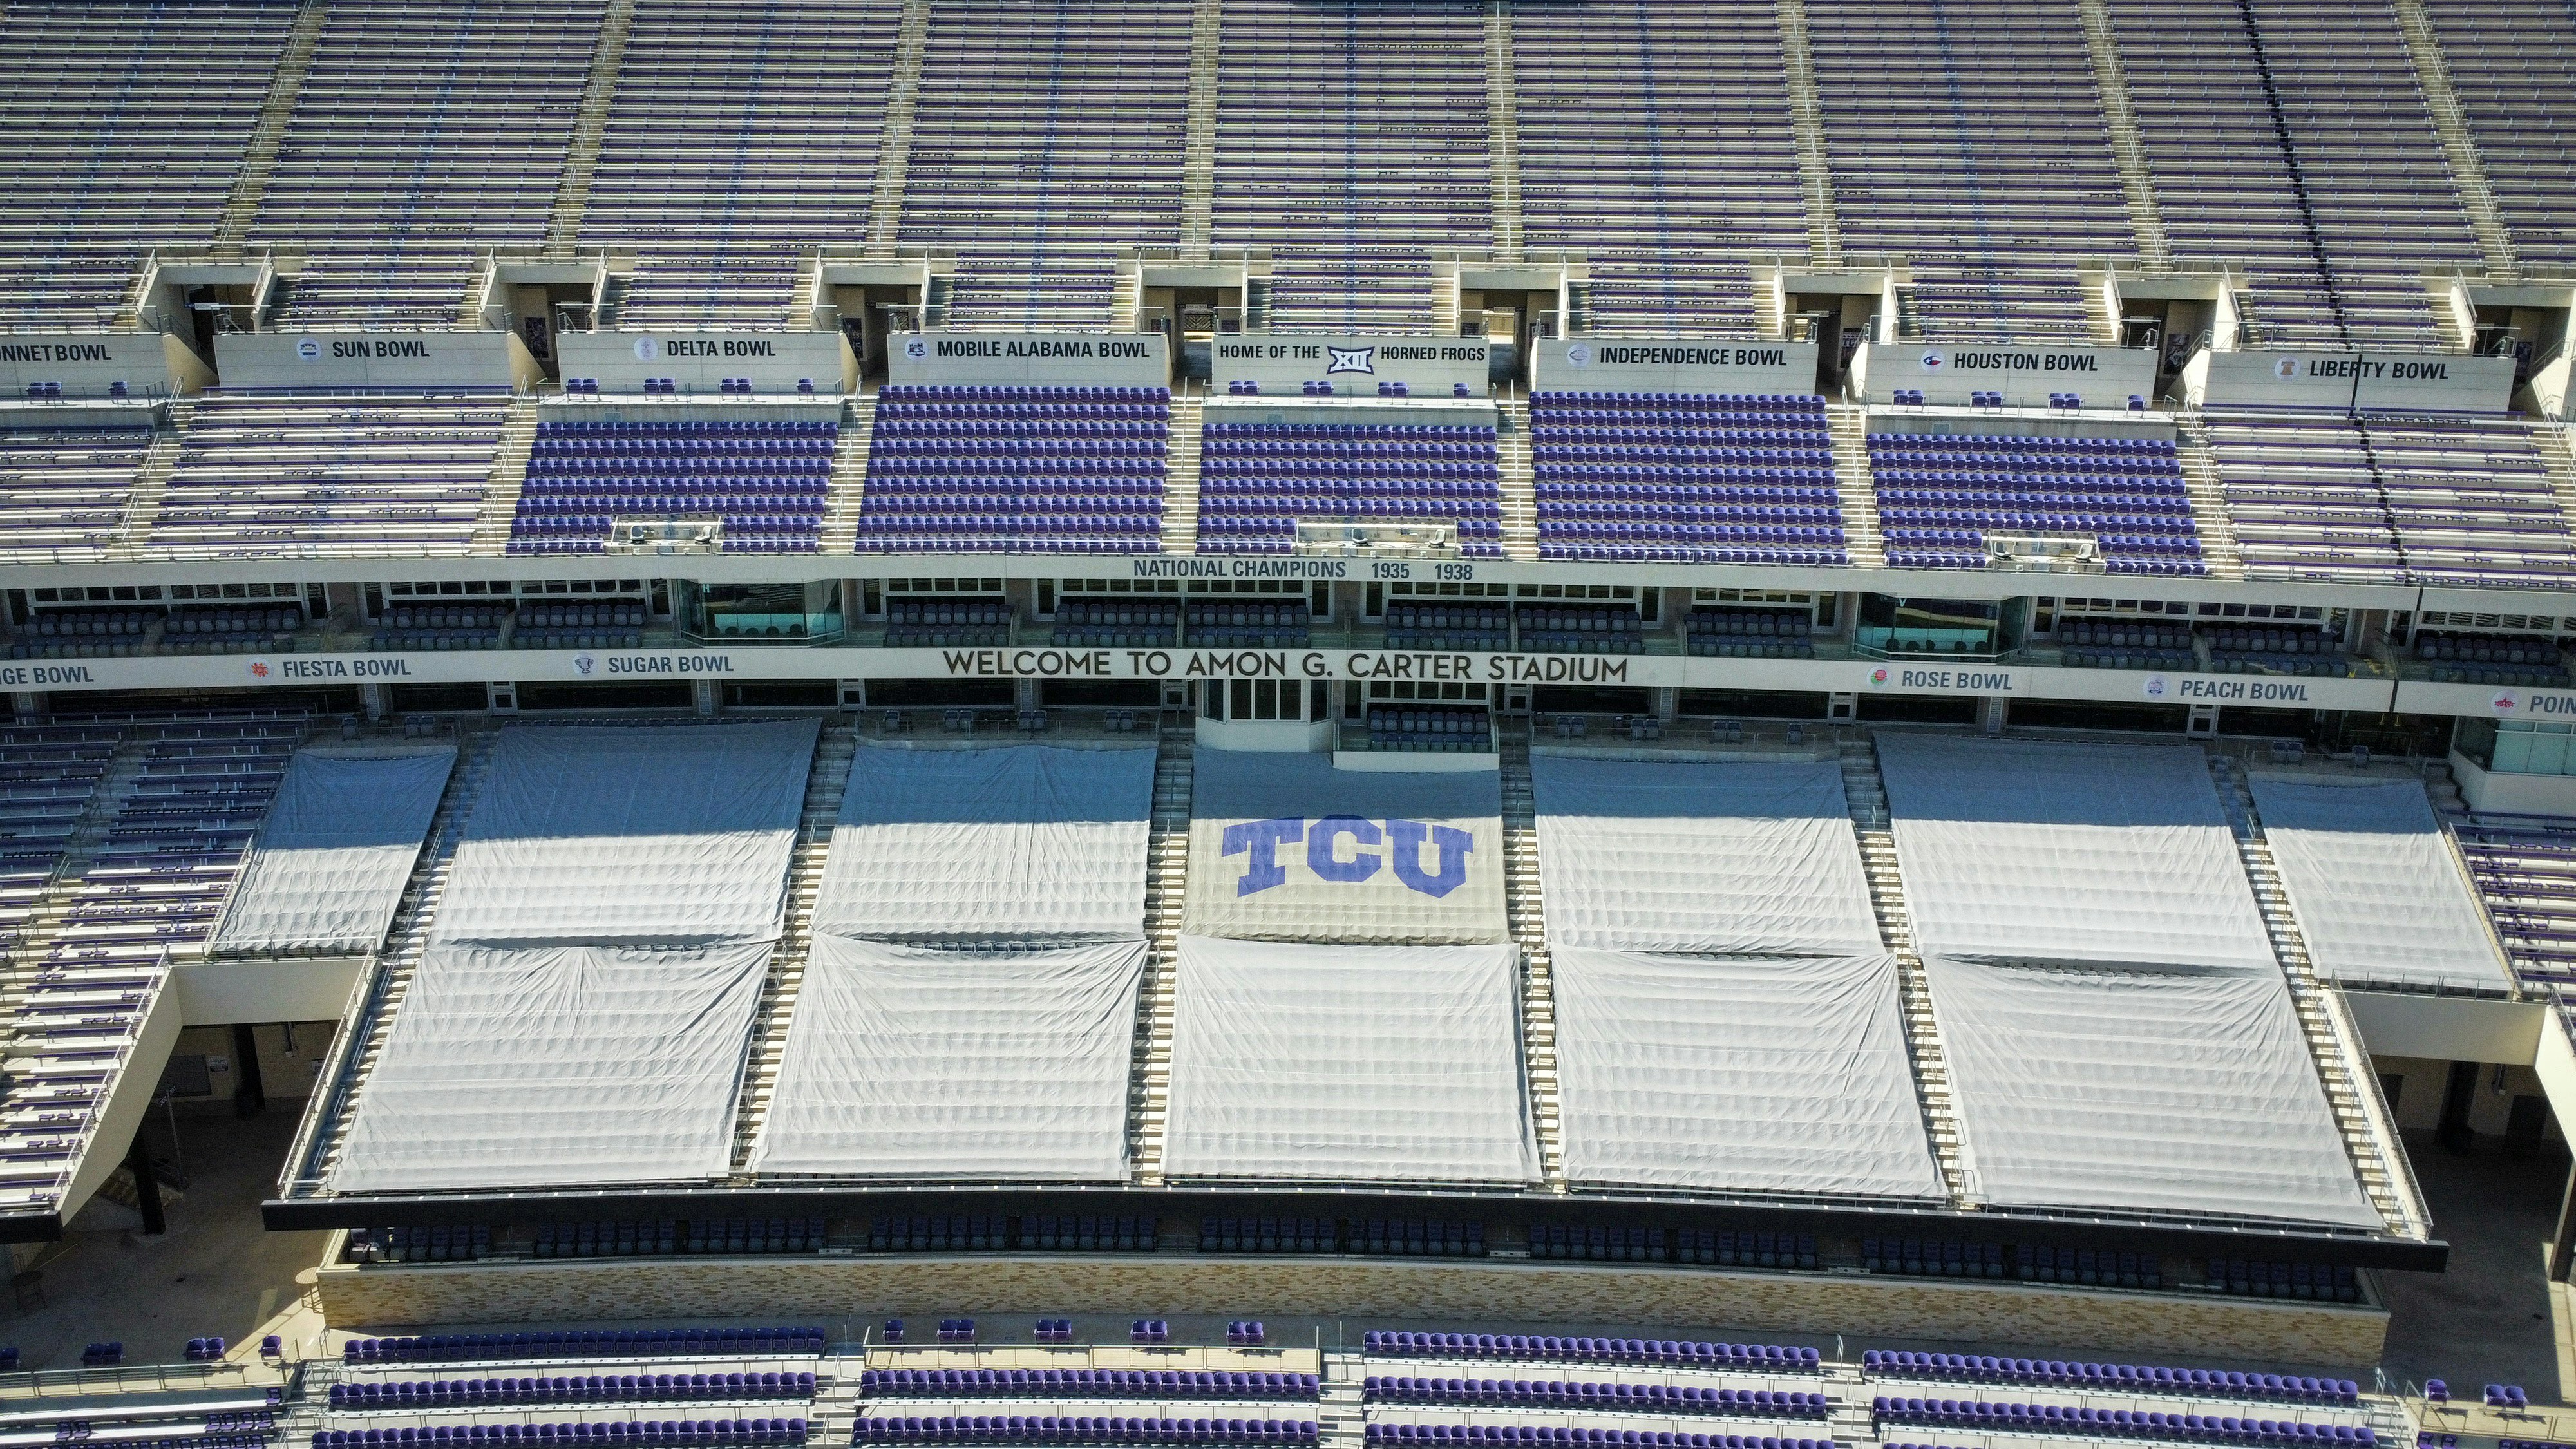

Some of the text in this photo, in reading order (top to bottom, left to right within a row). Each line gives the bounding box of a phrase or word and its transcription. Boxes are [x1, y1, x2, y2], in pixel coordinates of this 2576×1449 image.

[0, 345, 111, 361] NNET BOWL
[333, 341, 430, 357] SUN BOWL
[668, 341, 775, 356] DELTA BOWL
[938, 341, 1149, 357] MOBILE ALABAMA BOWL
[1220, 345, 1262, 357] HOME
[1269, 346, 1287, 358] OF
[1293, 346, 1320, 358] THE
[1381, 347, 1436, 359] HORNED
[1442, 348, 1484, 361] FROGS
[1600, 348, 1786, 365] INDEPENDENCE BOWL
[1955, 353, 2098, 371] HOUSTON BOWL
[2310, 361, 2448, 379] LIBERTY BOWL
[1134, 560, 1472, 580] NATIONAL CHAMPIONS 1935 1938
[283, 660, 411, 677] FIESTA BOWL
[609, 656, 734, 672] SUGAR BOWL
[943, 651, 1627, 682] WELCOME TO AMON G. CARTER STADIUM
[0, 667, 94, 685] GE BOWL
[1902, 671, 2012, 690] ROSE BOWL
[2181, 681, 2307, 701] PEACH BOWL
[2530, 696, 2576, 714] POIN
[1222, 814, 1473, 898] TCU
